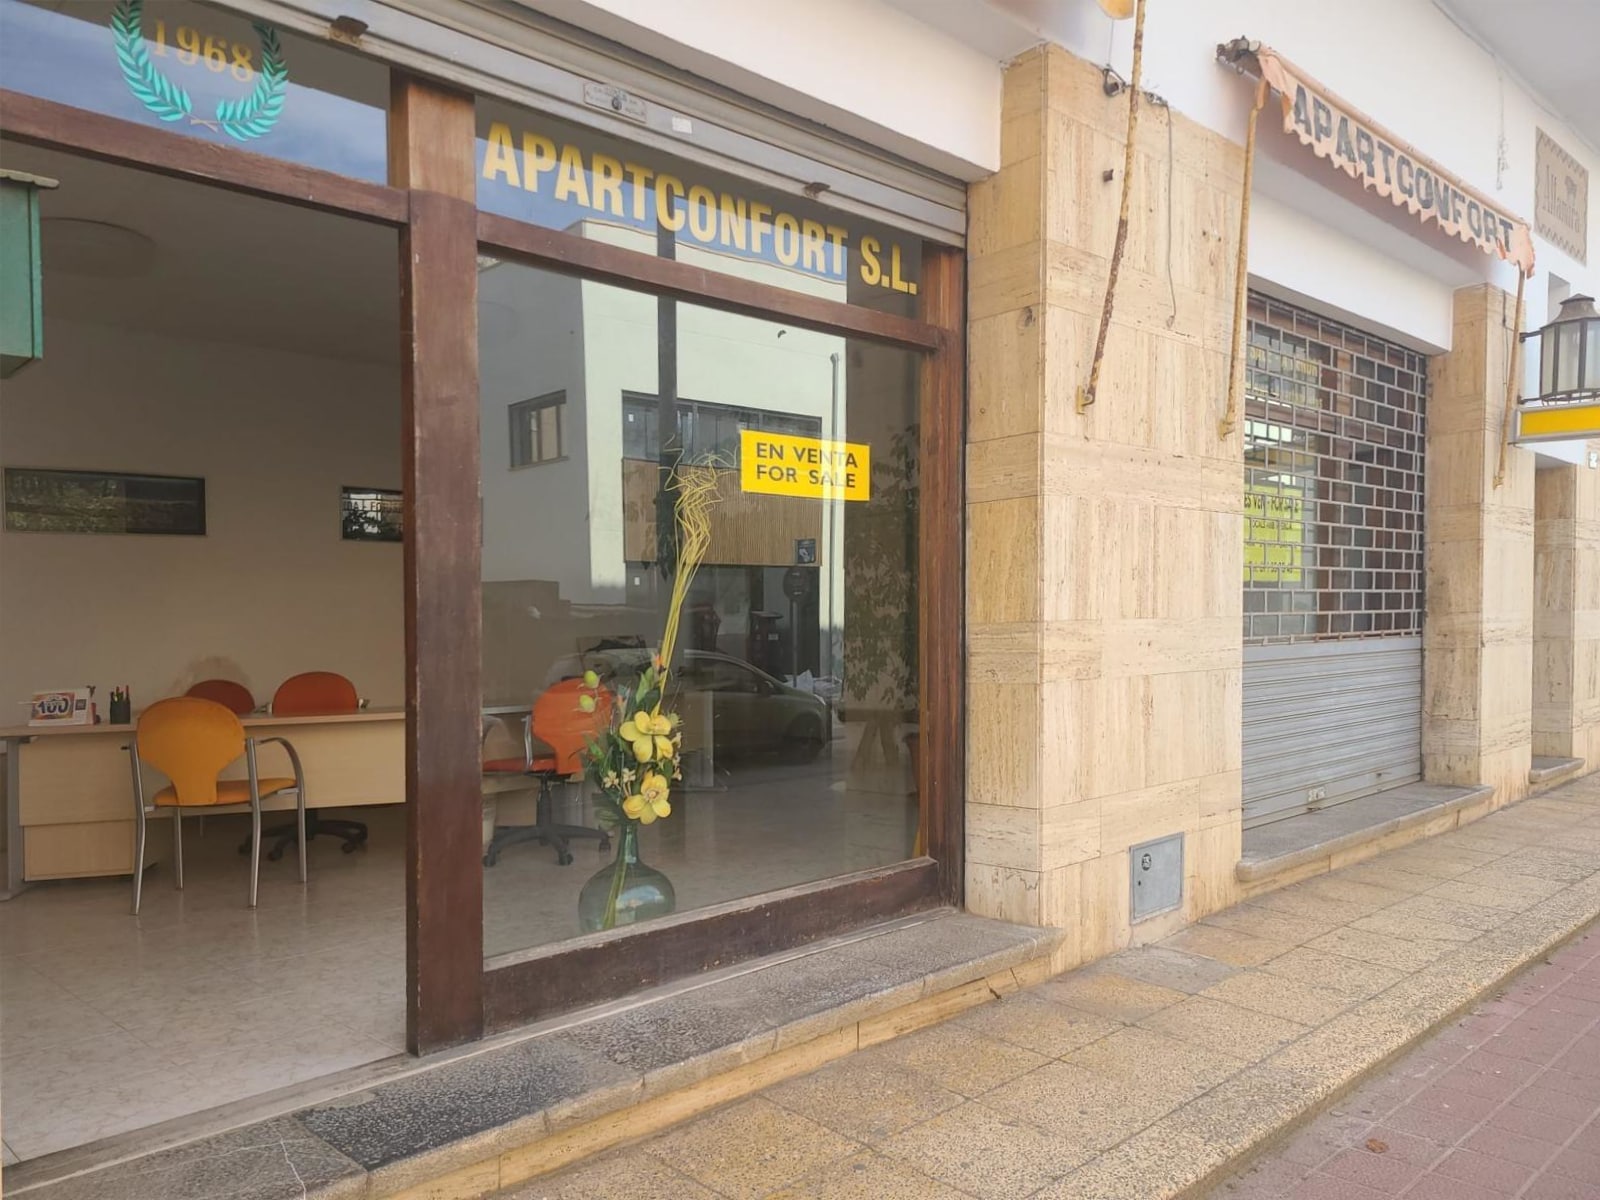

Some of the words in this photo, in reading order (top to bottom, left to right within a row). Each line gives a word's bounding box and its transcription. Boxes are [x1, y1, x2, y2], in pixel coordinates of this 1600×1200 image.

[154, 18, 254, 82] 1968
[1294, 83, 1514, 253] APARTCONFORT
[482, 121, 849, 276] APARTCONFORT
[859, 235, 918, 296] S.L.
[756, 442, 784, 460] EN
[793, 446, 858, 469] VENTA
[756, 464, 798, 483] FOR
[809, 469, 856, 488] SALE
